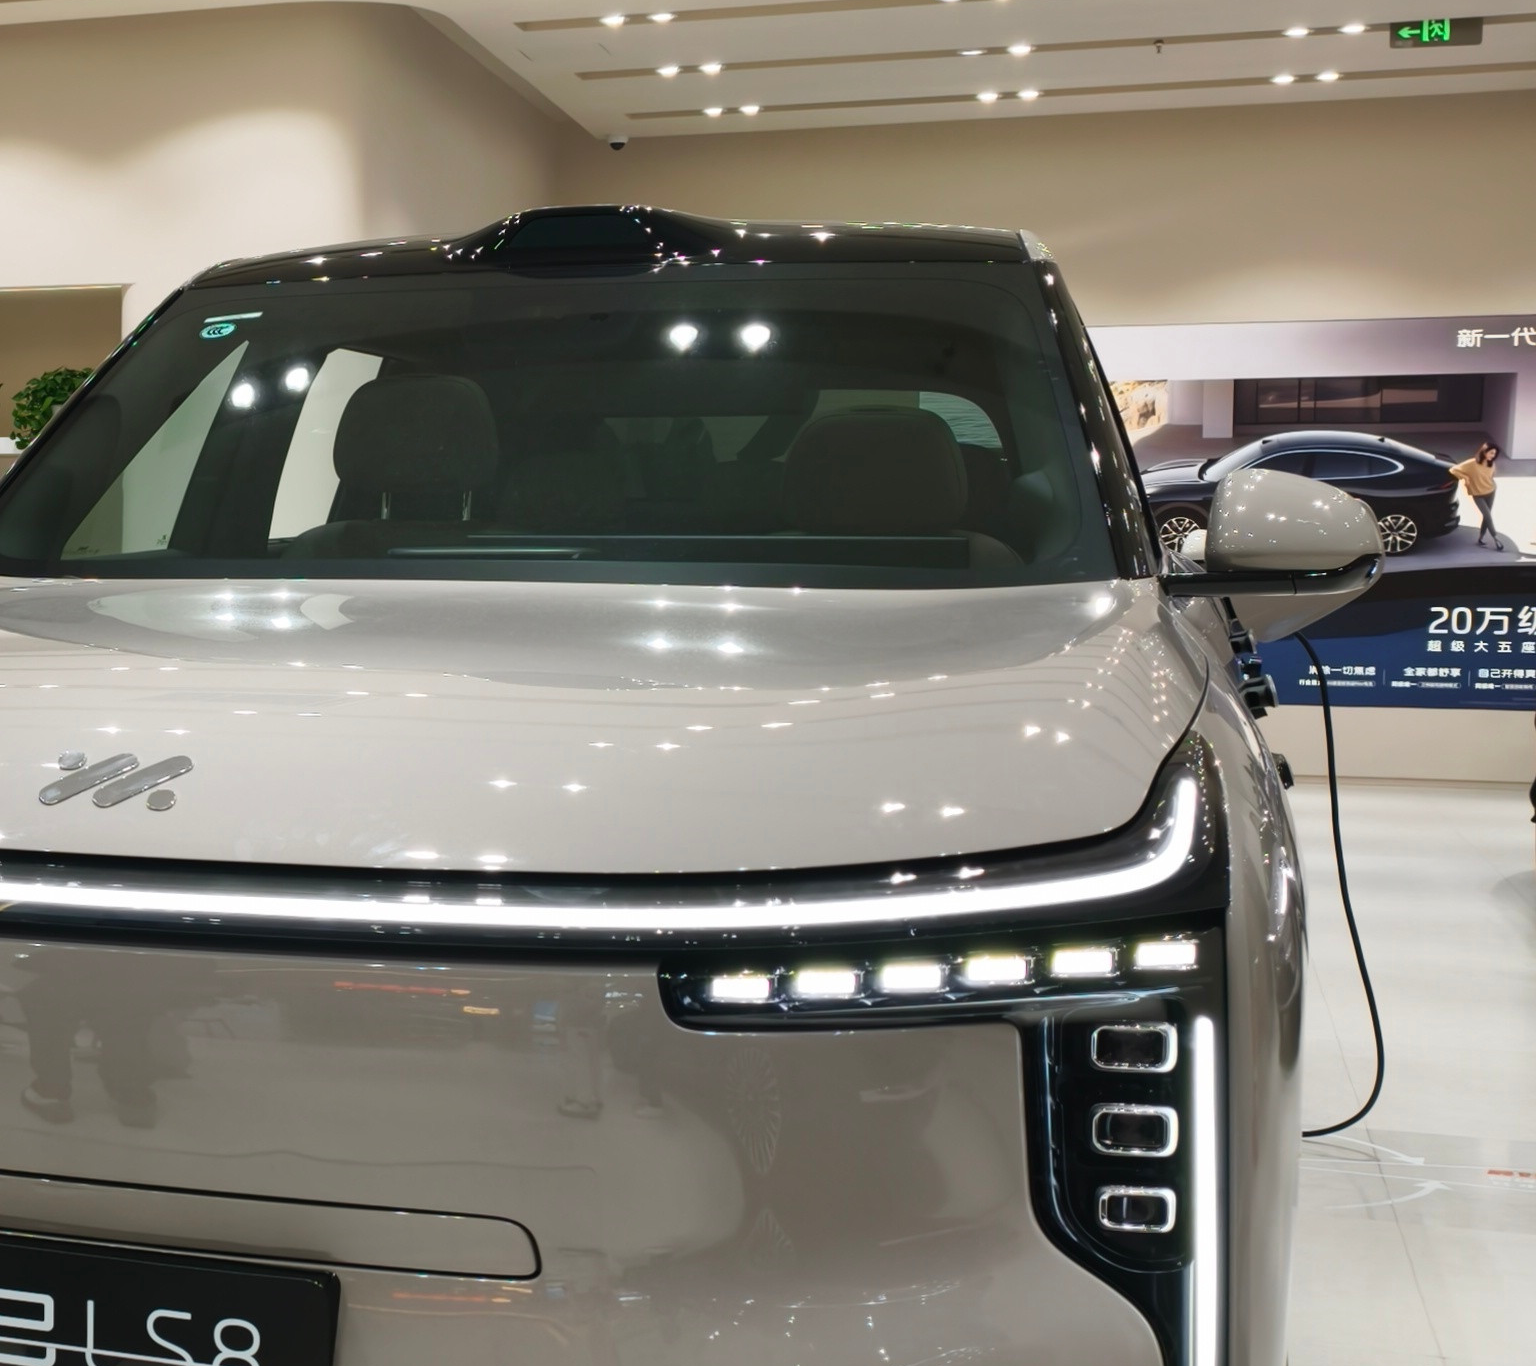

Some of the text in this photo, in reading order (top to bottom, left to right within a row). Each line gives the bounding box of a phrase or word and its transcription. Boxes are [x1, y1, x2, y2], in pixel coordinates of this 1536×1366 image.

[1457, 327, 1536, 348] 新一代
[1427, 640, 1536, 653] 超级大五座
